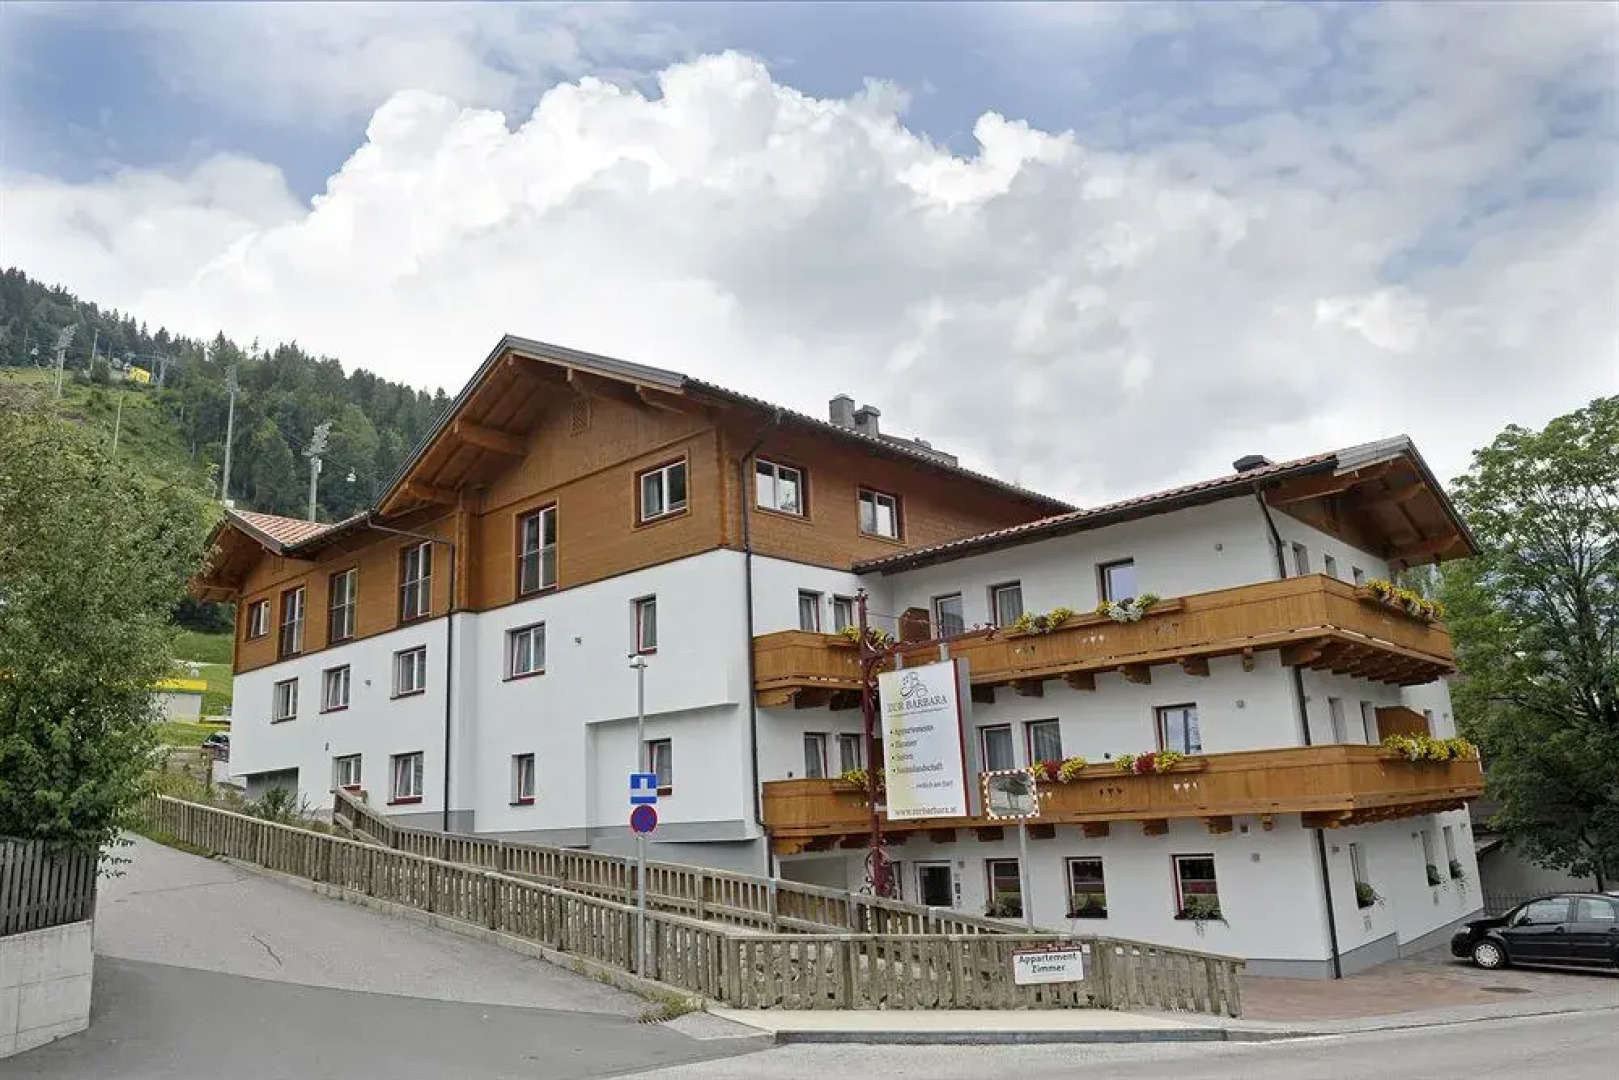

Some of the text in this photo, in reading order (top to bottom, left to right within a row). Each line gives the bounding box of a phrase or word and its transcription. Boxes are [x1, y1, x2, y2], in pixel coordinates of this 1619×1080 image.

[906, 695, 948, 710] BARBARA
[1020, 952, 1077, 965] Appartement
[1032, 964, 1065, 974] Zimmer
